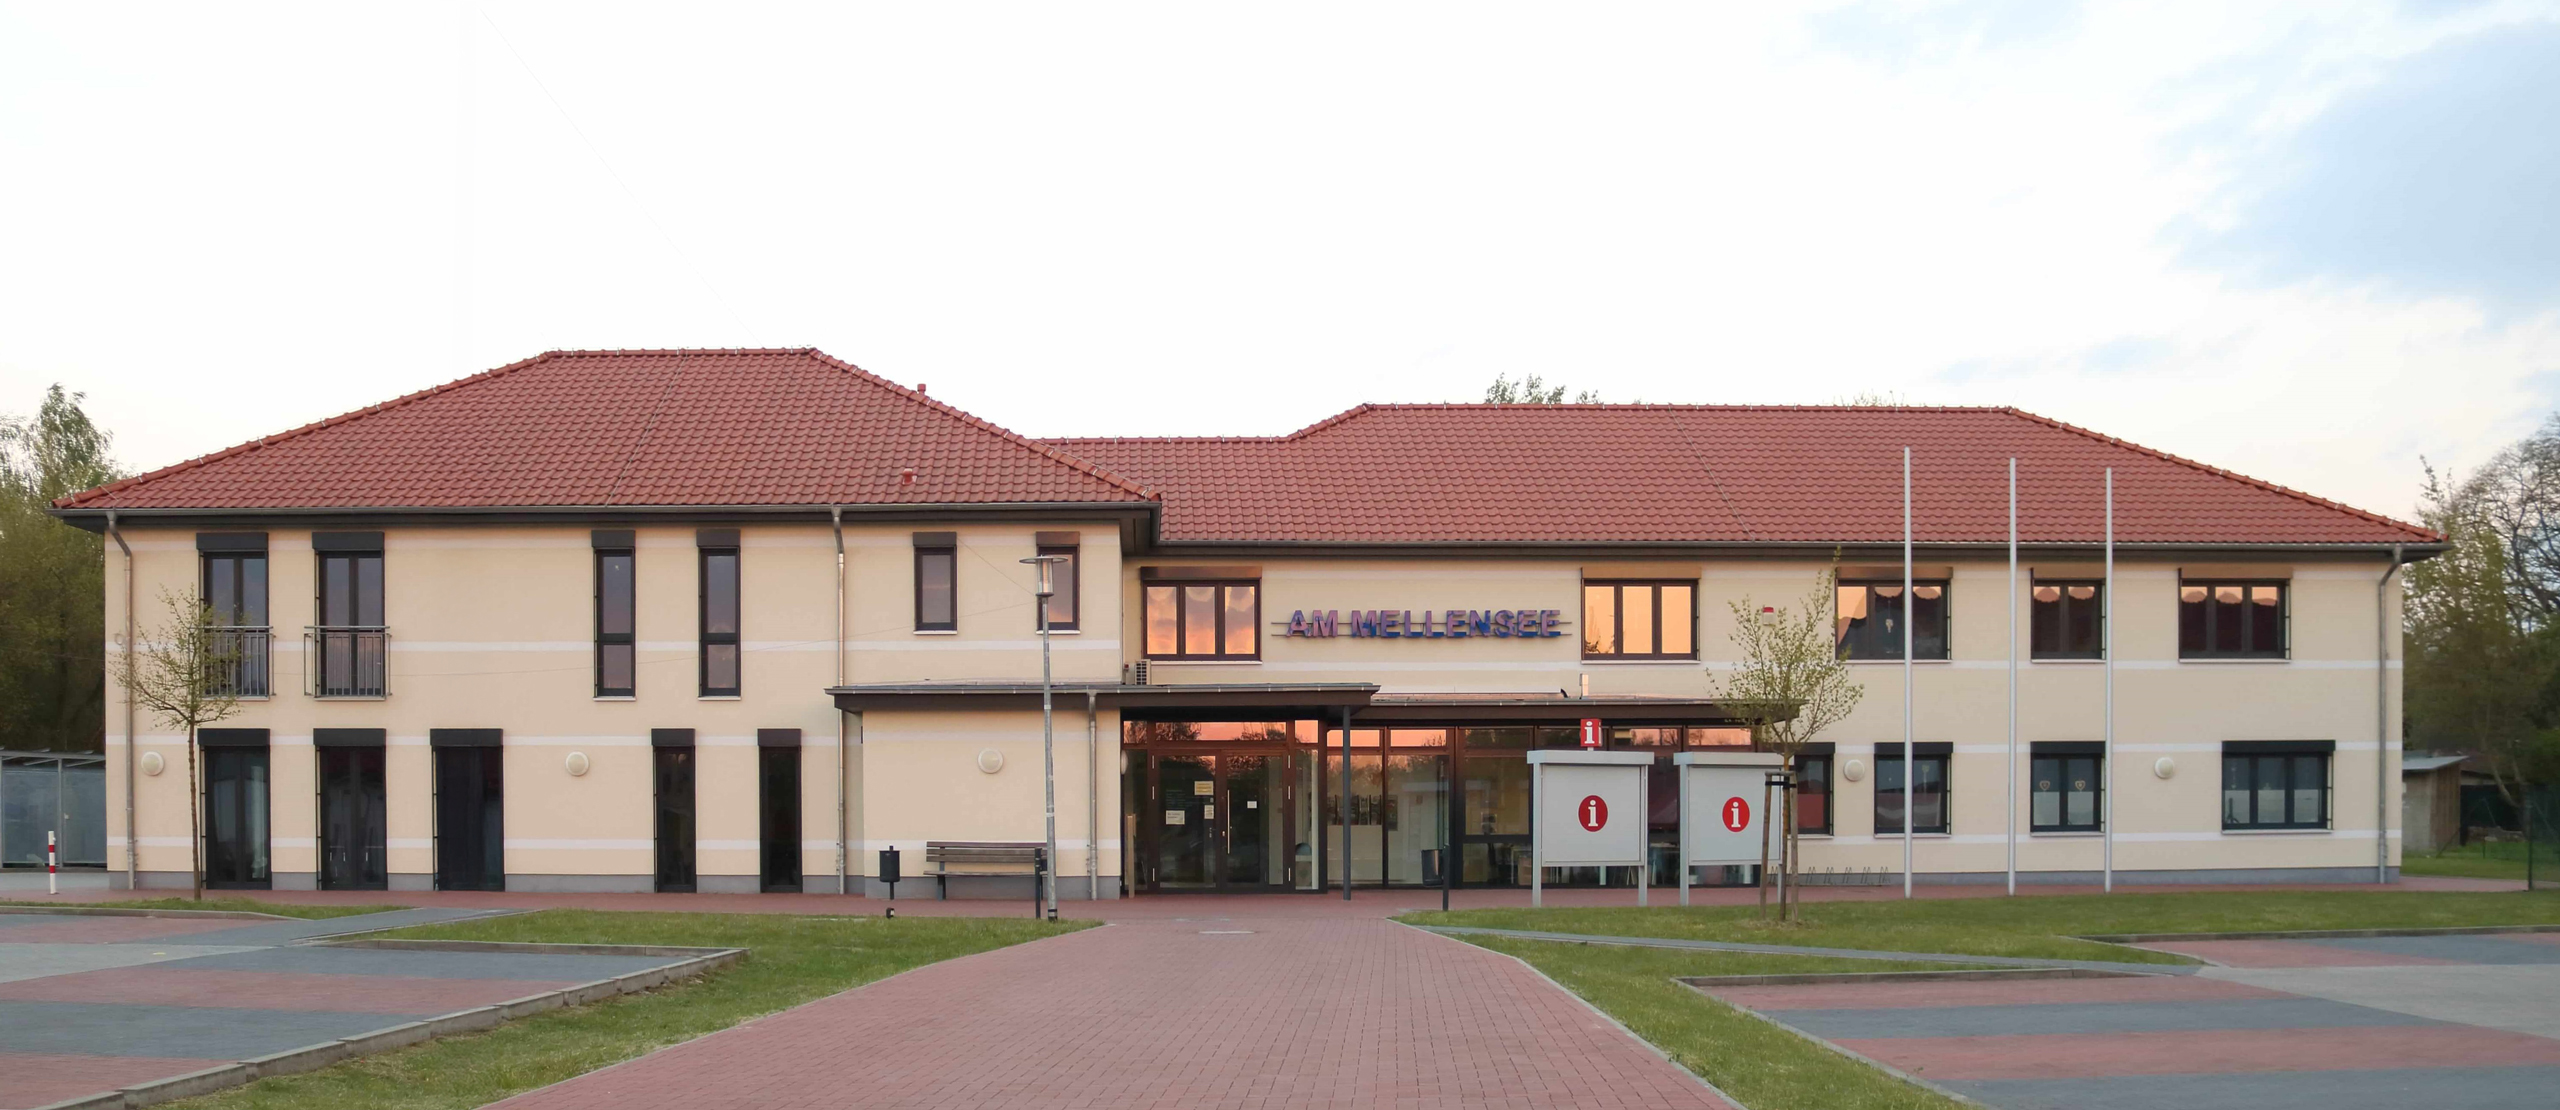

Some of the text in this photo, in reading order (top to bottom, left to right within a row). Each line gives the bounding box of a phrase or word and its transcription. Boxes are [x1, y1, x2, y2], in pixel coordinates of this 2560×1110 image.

[1288, 609, 1561, 638] AM MELLENSEE
[1584, 721, 1595, 744] i
[1588, 799, 1598, 827] i
[1731, 801, 1741, 828] i
